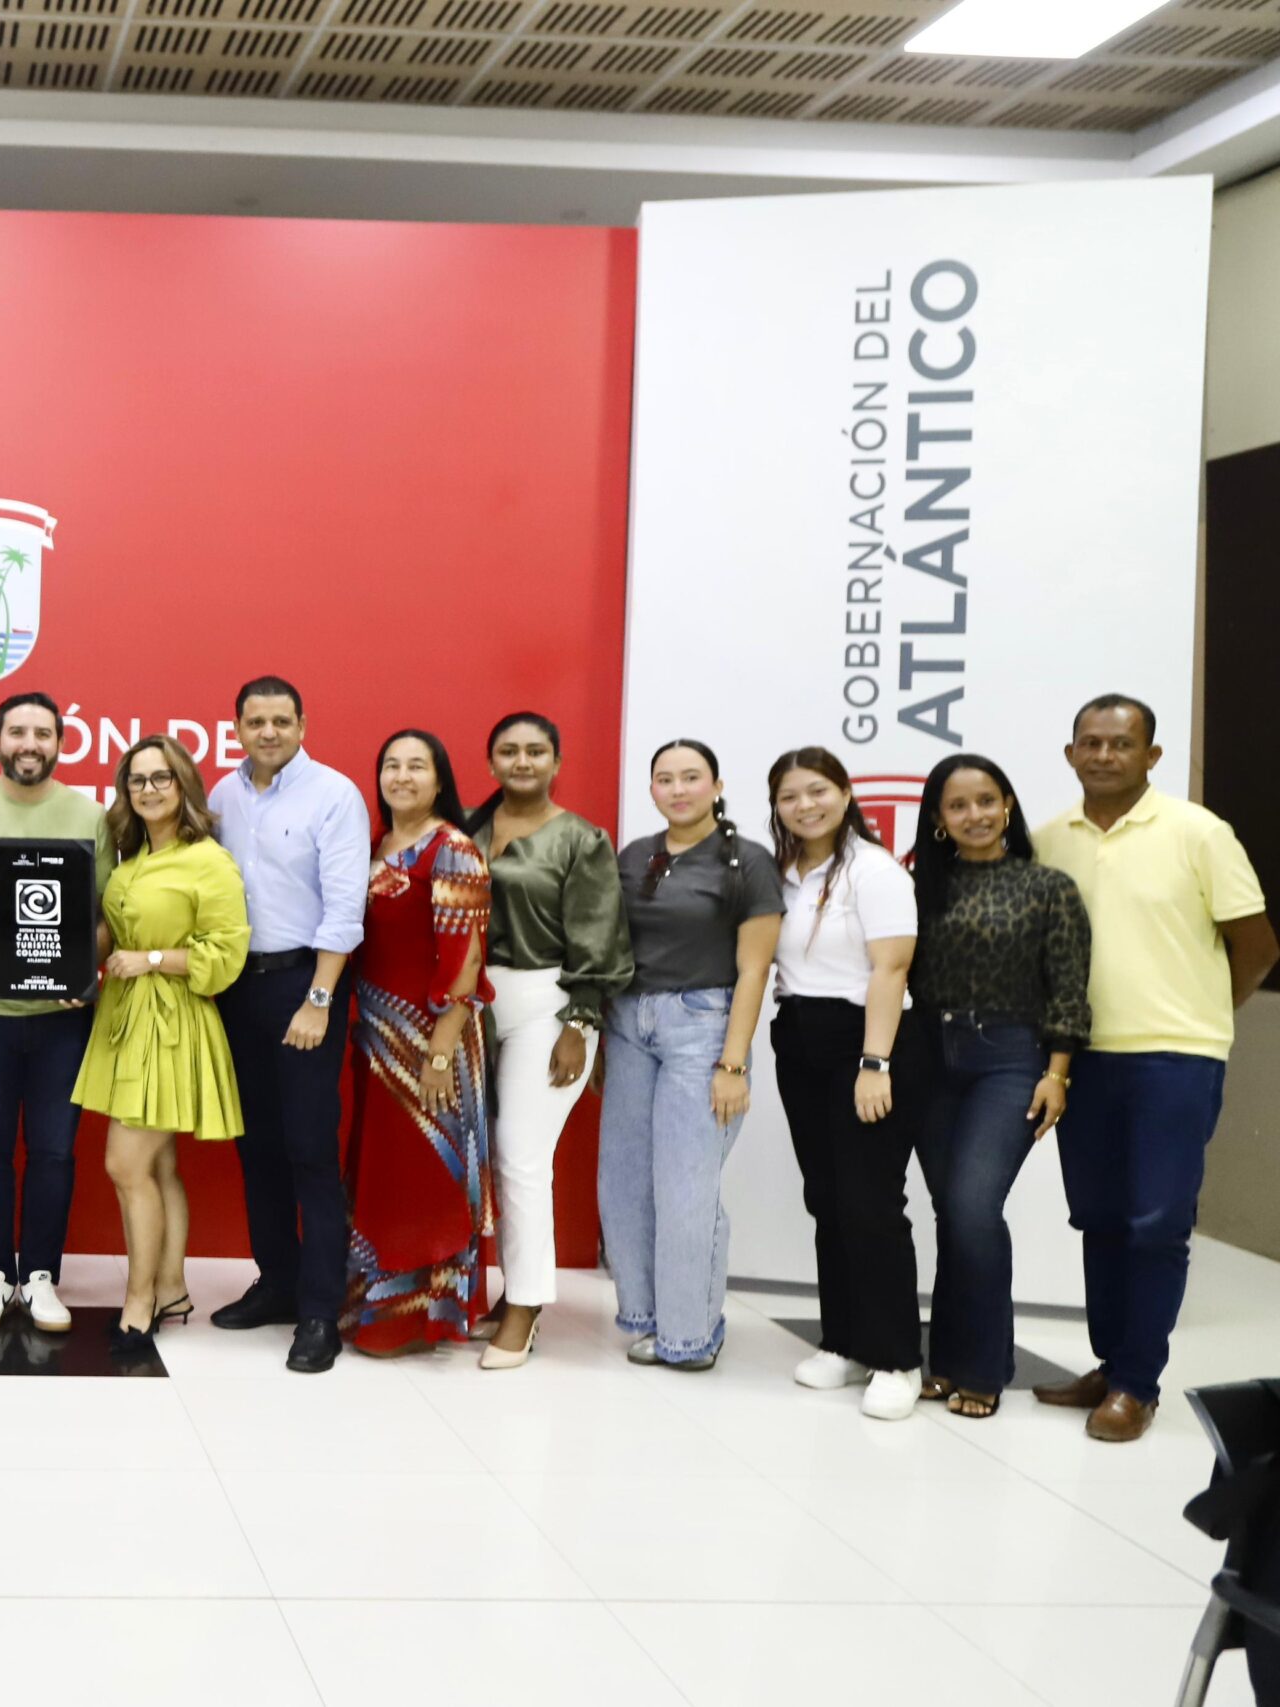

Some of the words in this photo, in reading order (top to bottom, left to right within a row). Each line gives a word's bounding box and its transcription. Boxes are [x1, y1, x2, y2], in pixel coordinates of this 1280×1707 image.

[854, 269, 892, 361] DEL
[883, 258, 979, 748] ATLÁNTICO
[841, 382, 889, 745] GOBERNACIÓN
[167, 719, 244, 769] DE
[16, 933, 61, 942] CALIDAD
[16, 949, 61, 958] COLOMBIA
